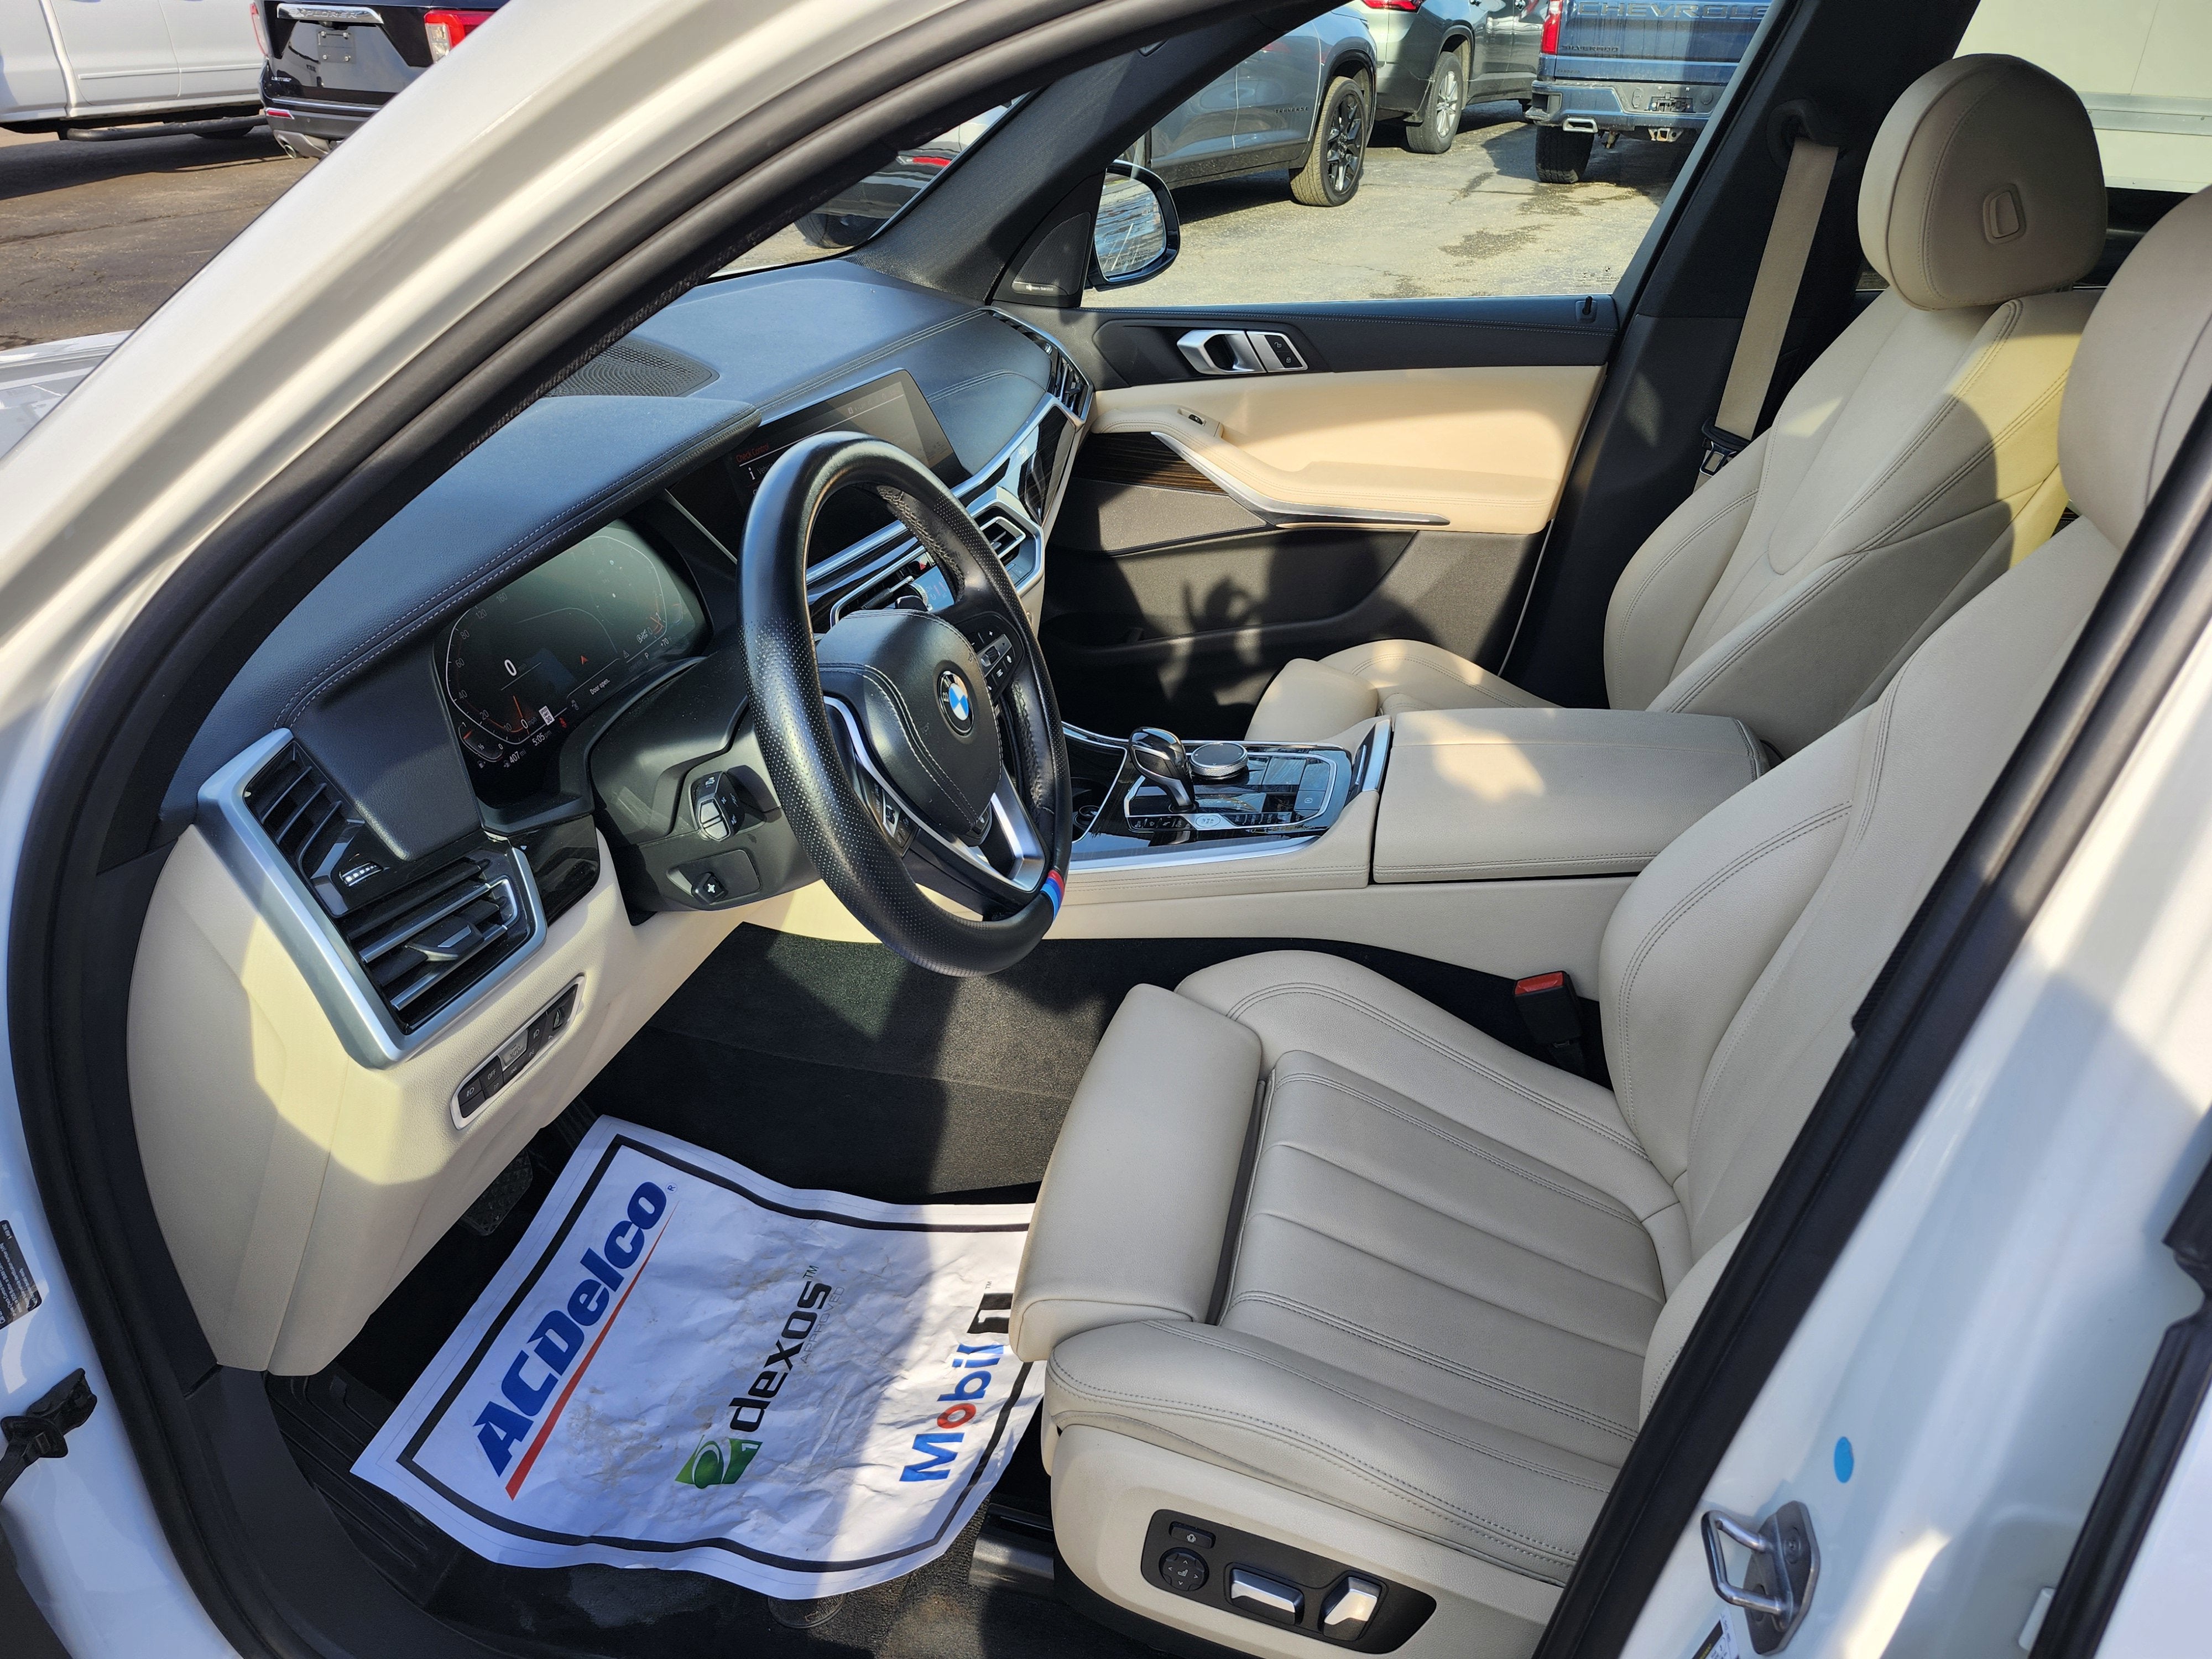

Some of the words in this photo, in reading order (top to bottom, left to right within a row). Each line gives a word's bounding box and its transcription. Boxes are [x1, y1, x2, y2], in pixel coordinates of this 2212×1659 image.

[288, 7, 358, 19] EXPLORER
[1578, 2, 1770, 19] CHEVROLE
[497, 592, 508, 603] 160
[476, 609, 487, 619] 120
[460, 629, 470, 640] 80
[455, 658, 465, 668] 60
[504, 659, 518, 676] 0
[458, 689, 468, 700] 40
[589, 685, 600, 695] Door
[479, 709, 489, 721] 20
[504, 723, 512, 732] 10
[520, 719, 528, 729] 0
[532, 732, 545, 747] 5:05
[509, 751, 520, 763] 407
[487, 1070, 497, 1080] OFF
[473, 1181, 667, 1478] ACDelco
[800, 1286, 845, 1364] APPROVED
[729, 1281, 832, 1432] dexos
[899, 1344, 1004, 1482] Mobil
